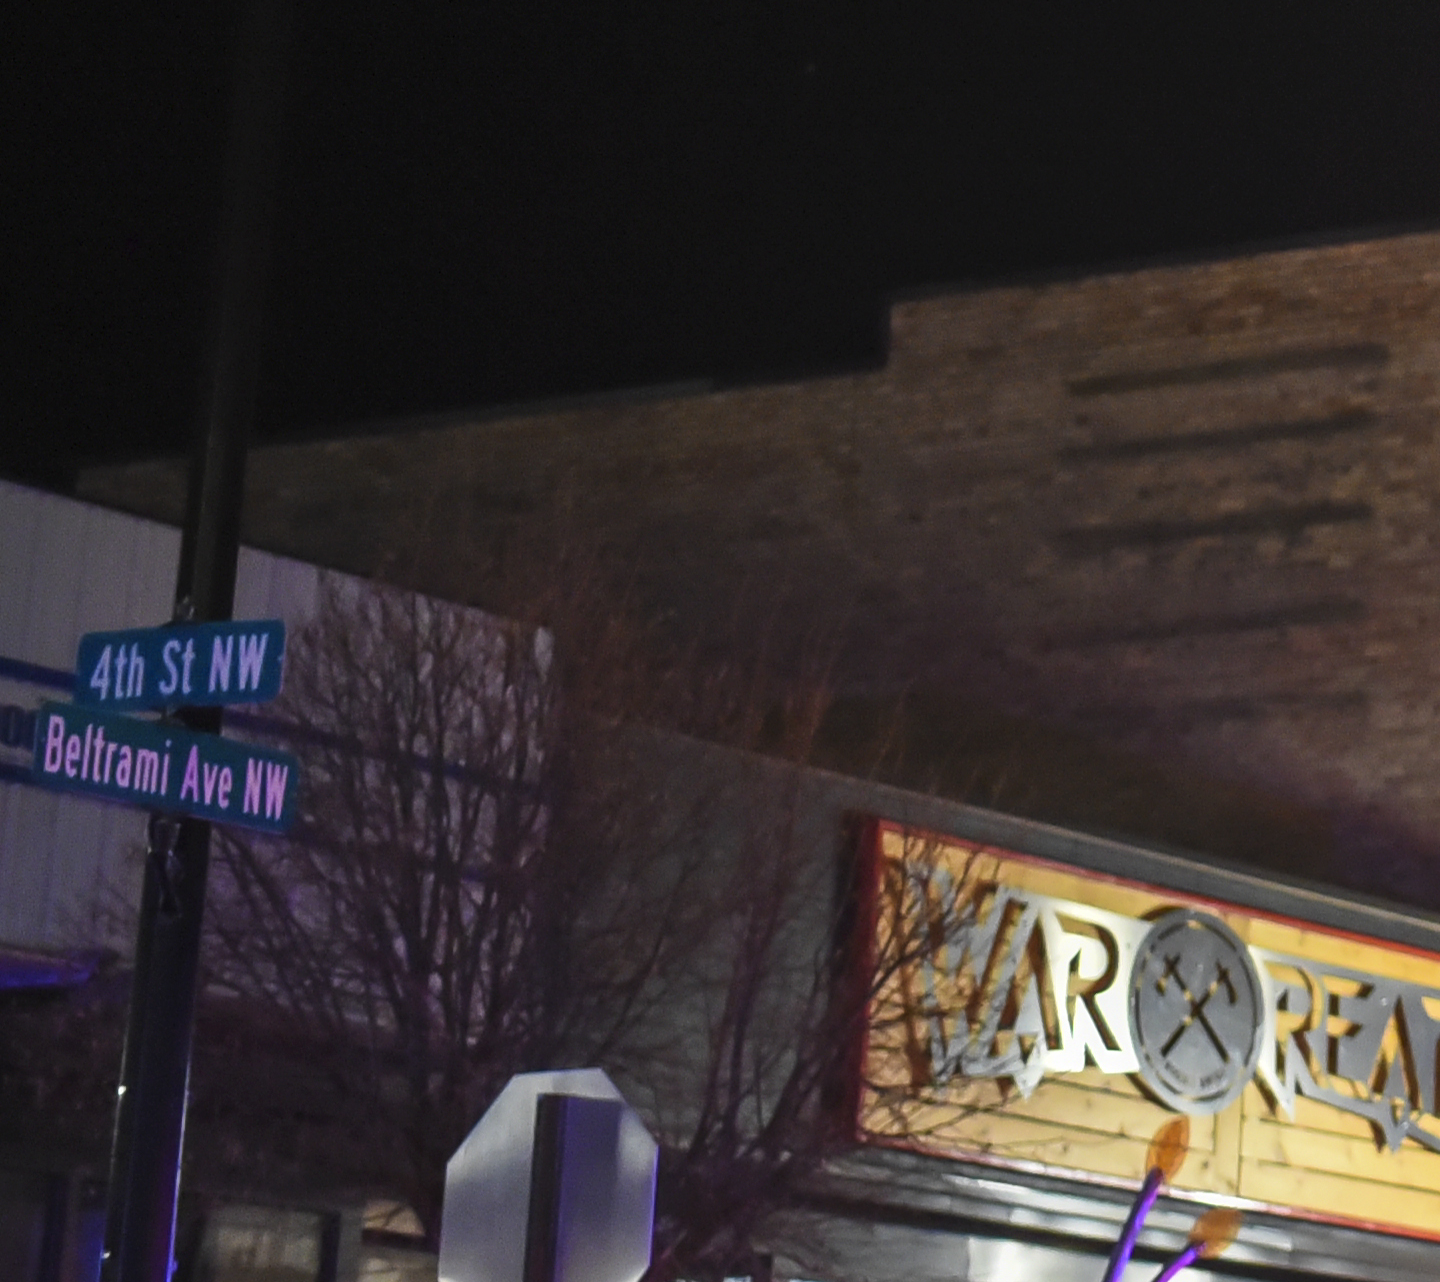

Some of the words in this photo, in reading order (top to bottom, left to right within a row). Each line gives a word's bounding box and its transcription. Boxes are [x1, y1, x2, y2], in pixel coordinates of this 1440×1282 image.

[90, 642, 145, 701] 4th
[158, 639, 196, 696] St
[208, 632, 270, 694] NW
[43, 714, 172, 797] Beltrami
[180, 744, 233, 809] Ave
[243, 757, 289, 821] NW
